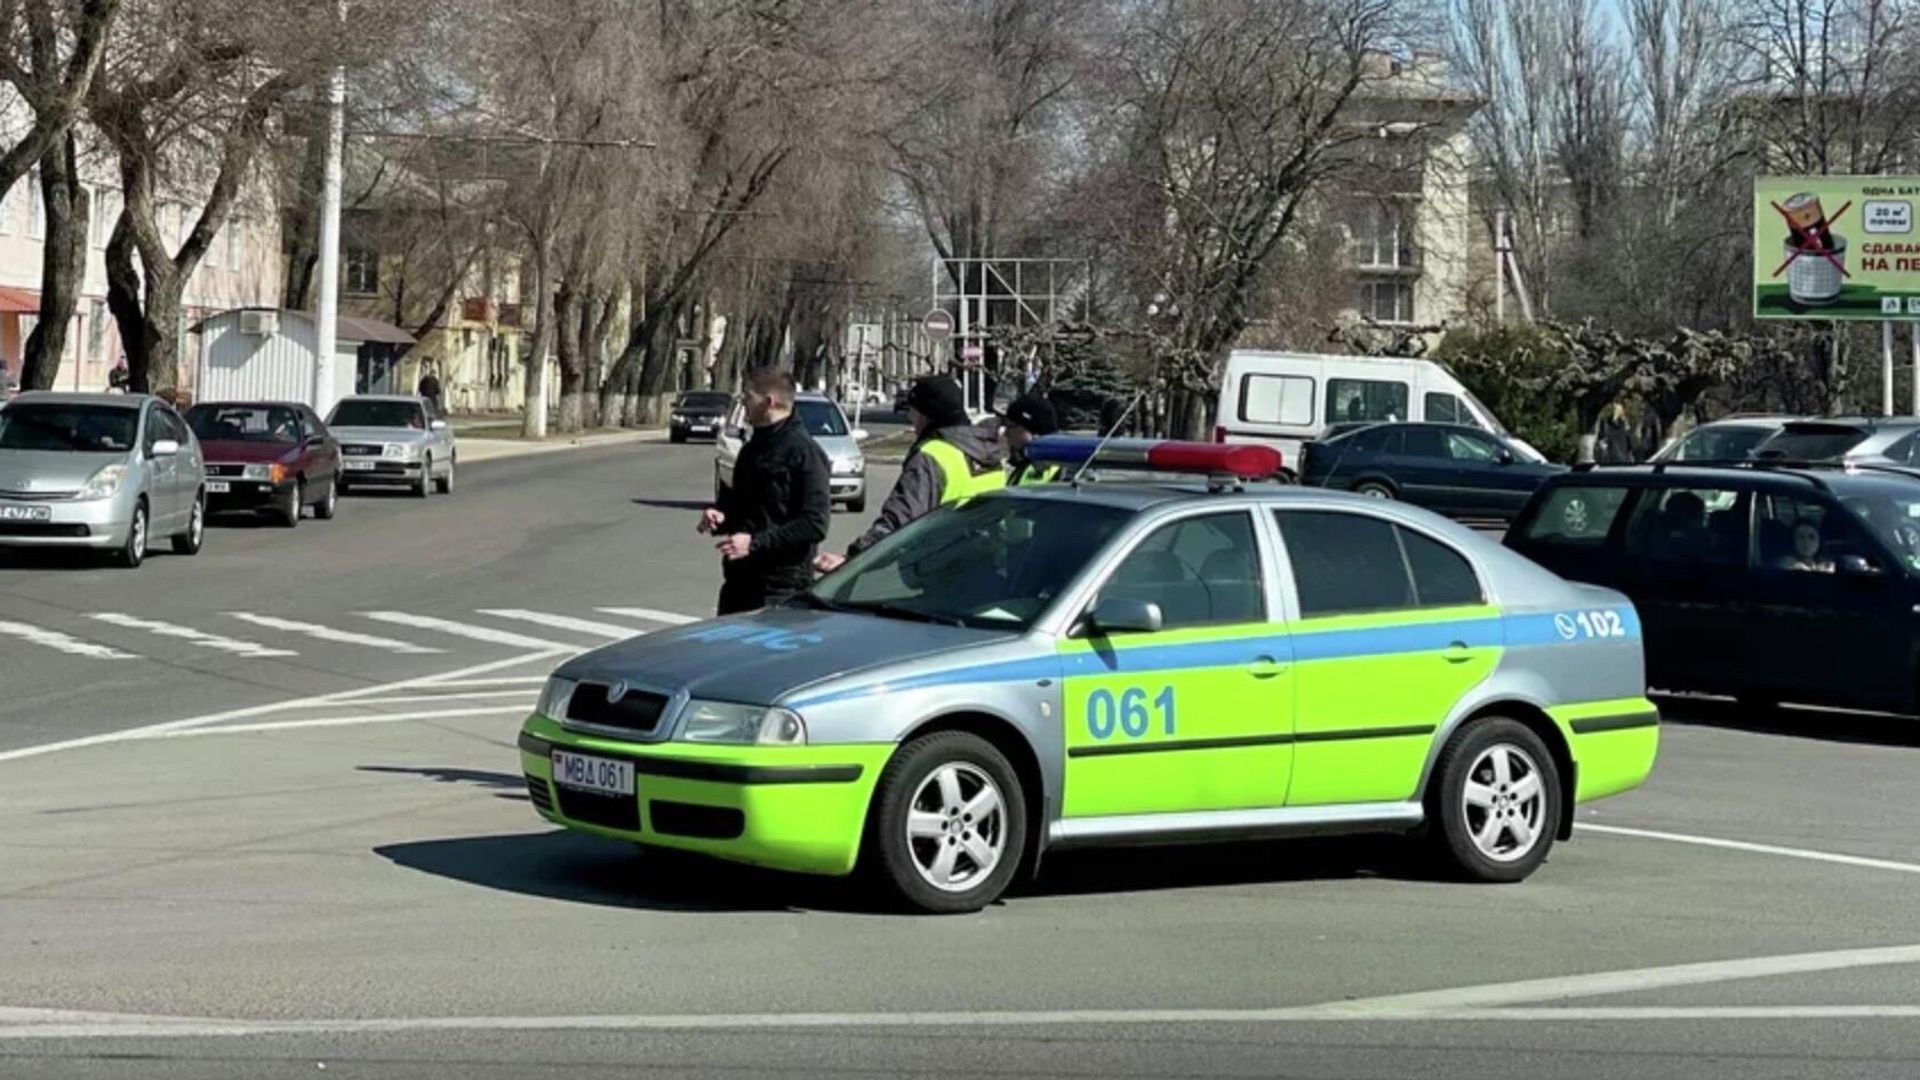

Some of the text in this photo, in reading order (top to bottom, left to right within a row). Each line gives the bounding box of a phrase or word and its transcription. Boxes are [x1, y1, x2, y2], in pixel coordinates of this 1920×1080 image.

[1862, 186, 1894, 196] ОДНА
[1876, 207, 1890, 216] 20
[1862, 258, 1920, 271] НА ПЕ
[1577, 610, 1625, 638] 102
[1087, 686, 1175, 739] 061
[599, 761, 625, 790] 061
